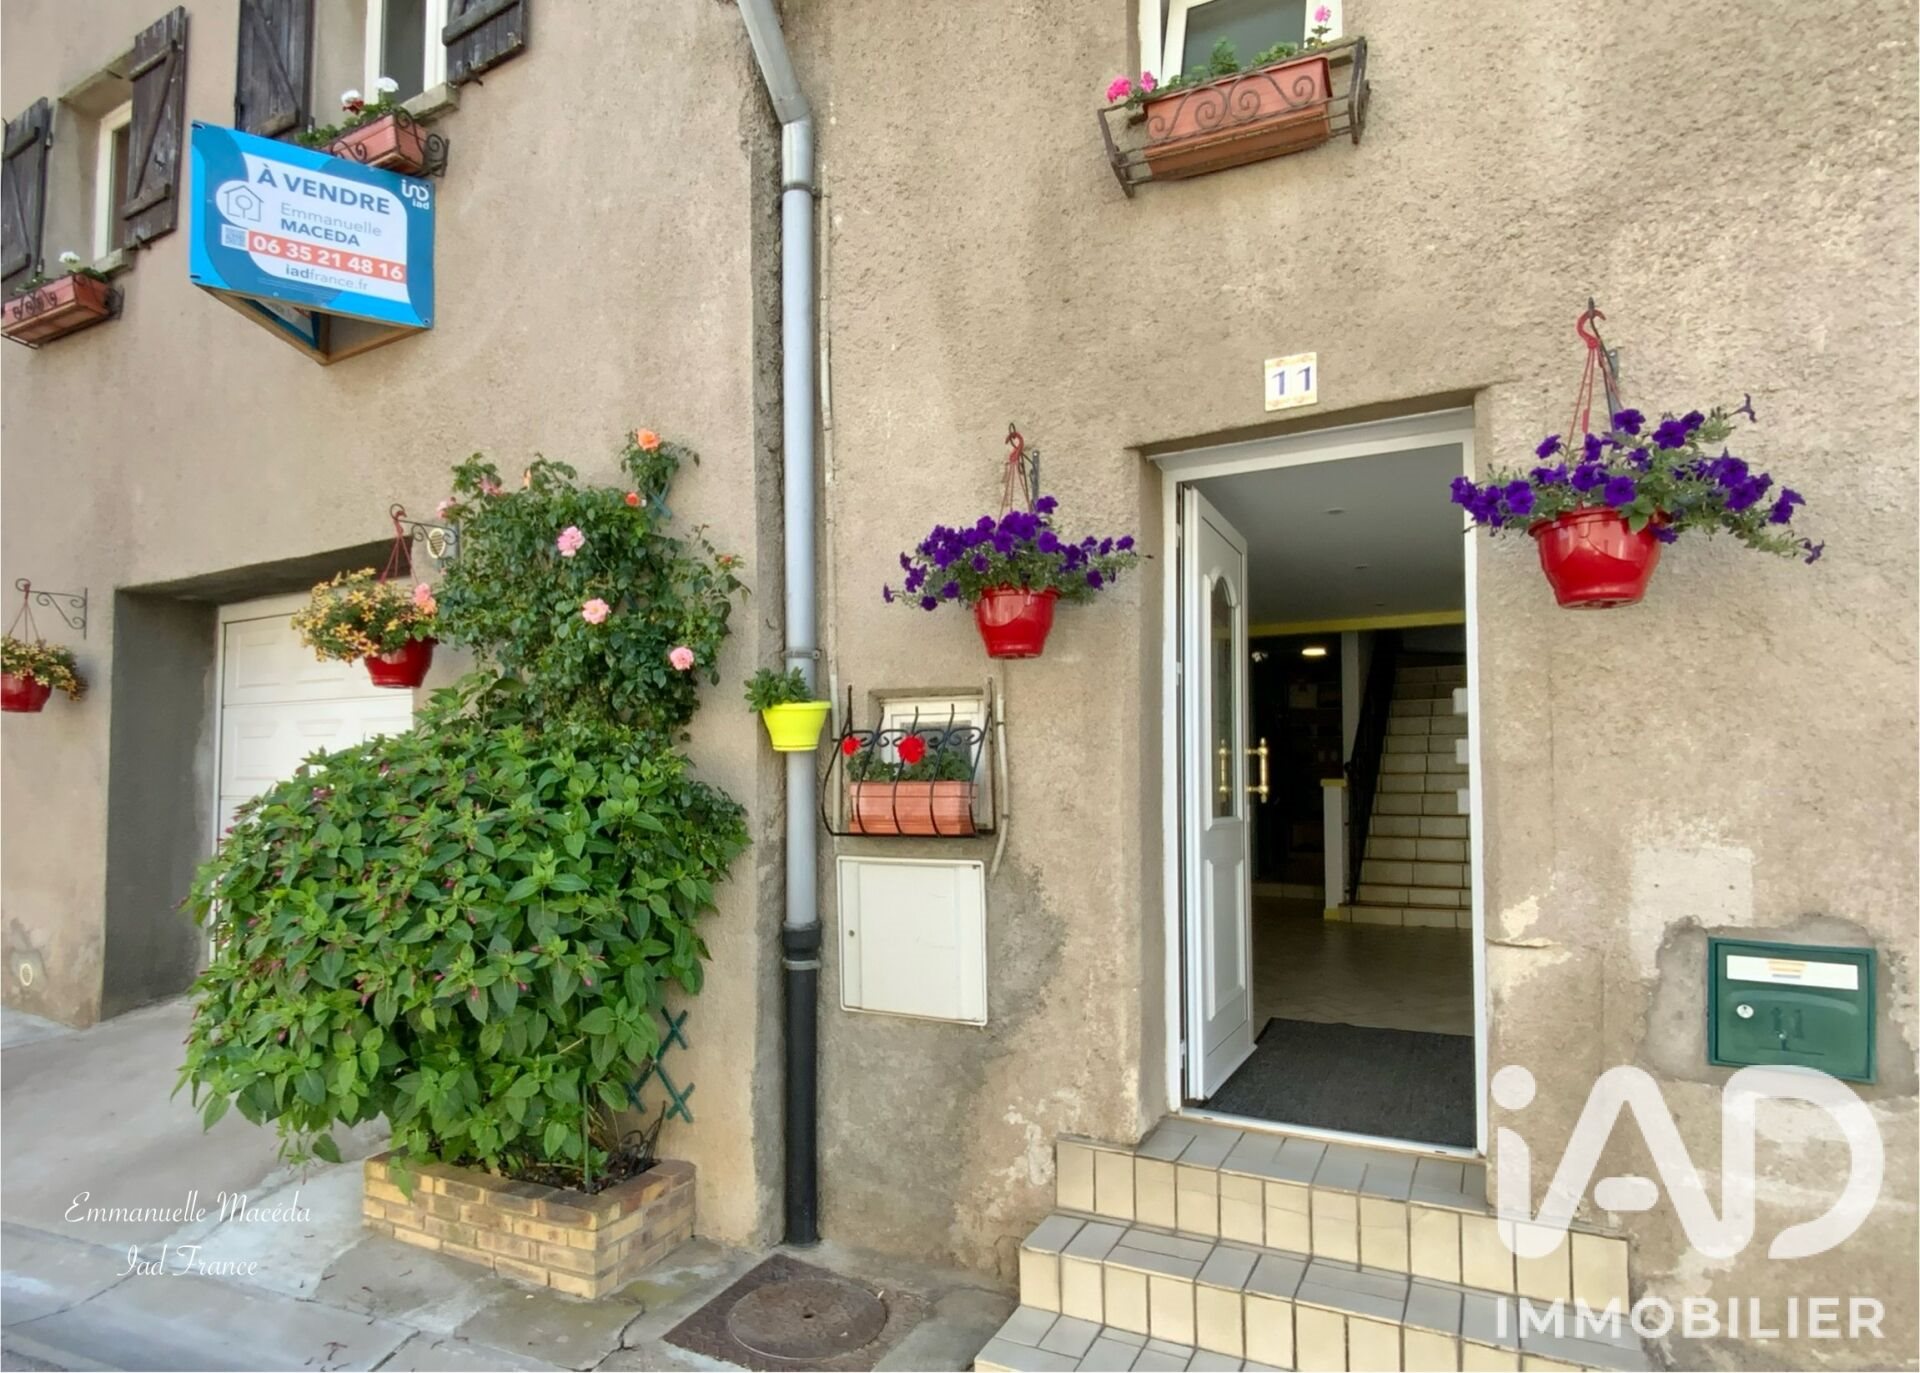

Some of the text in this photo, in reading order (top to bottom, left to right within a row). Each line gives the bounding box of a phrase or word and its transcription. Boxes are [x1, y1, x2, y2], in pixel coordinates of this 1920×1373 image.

[257, 163, 391, 215] À VENDRE
[411, 197, 430, 210] iad
[280, 201, 383, 237] Emmanuelle
[280, 218, 361, 247] MACEDA
[253, 235, 404, 281] 06 35 21 48 16
[285, 263, 369, 291] iadfrance.fr
[1272, 366, 1311, 396] 11
